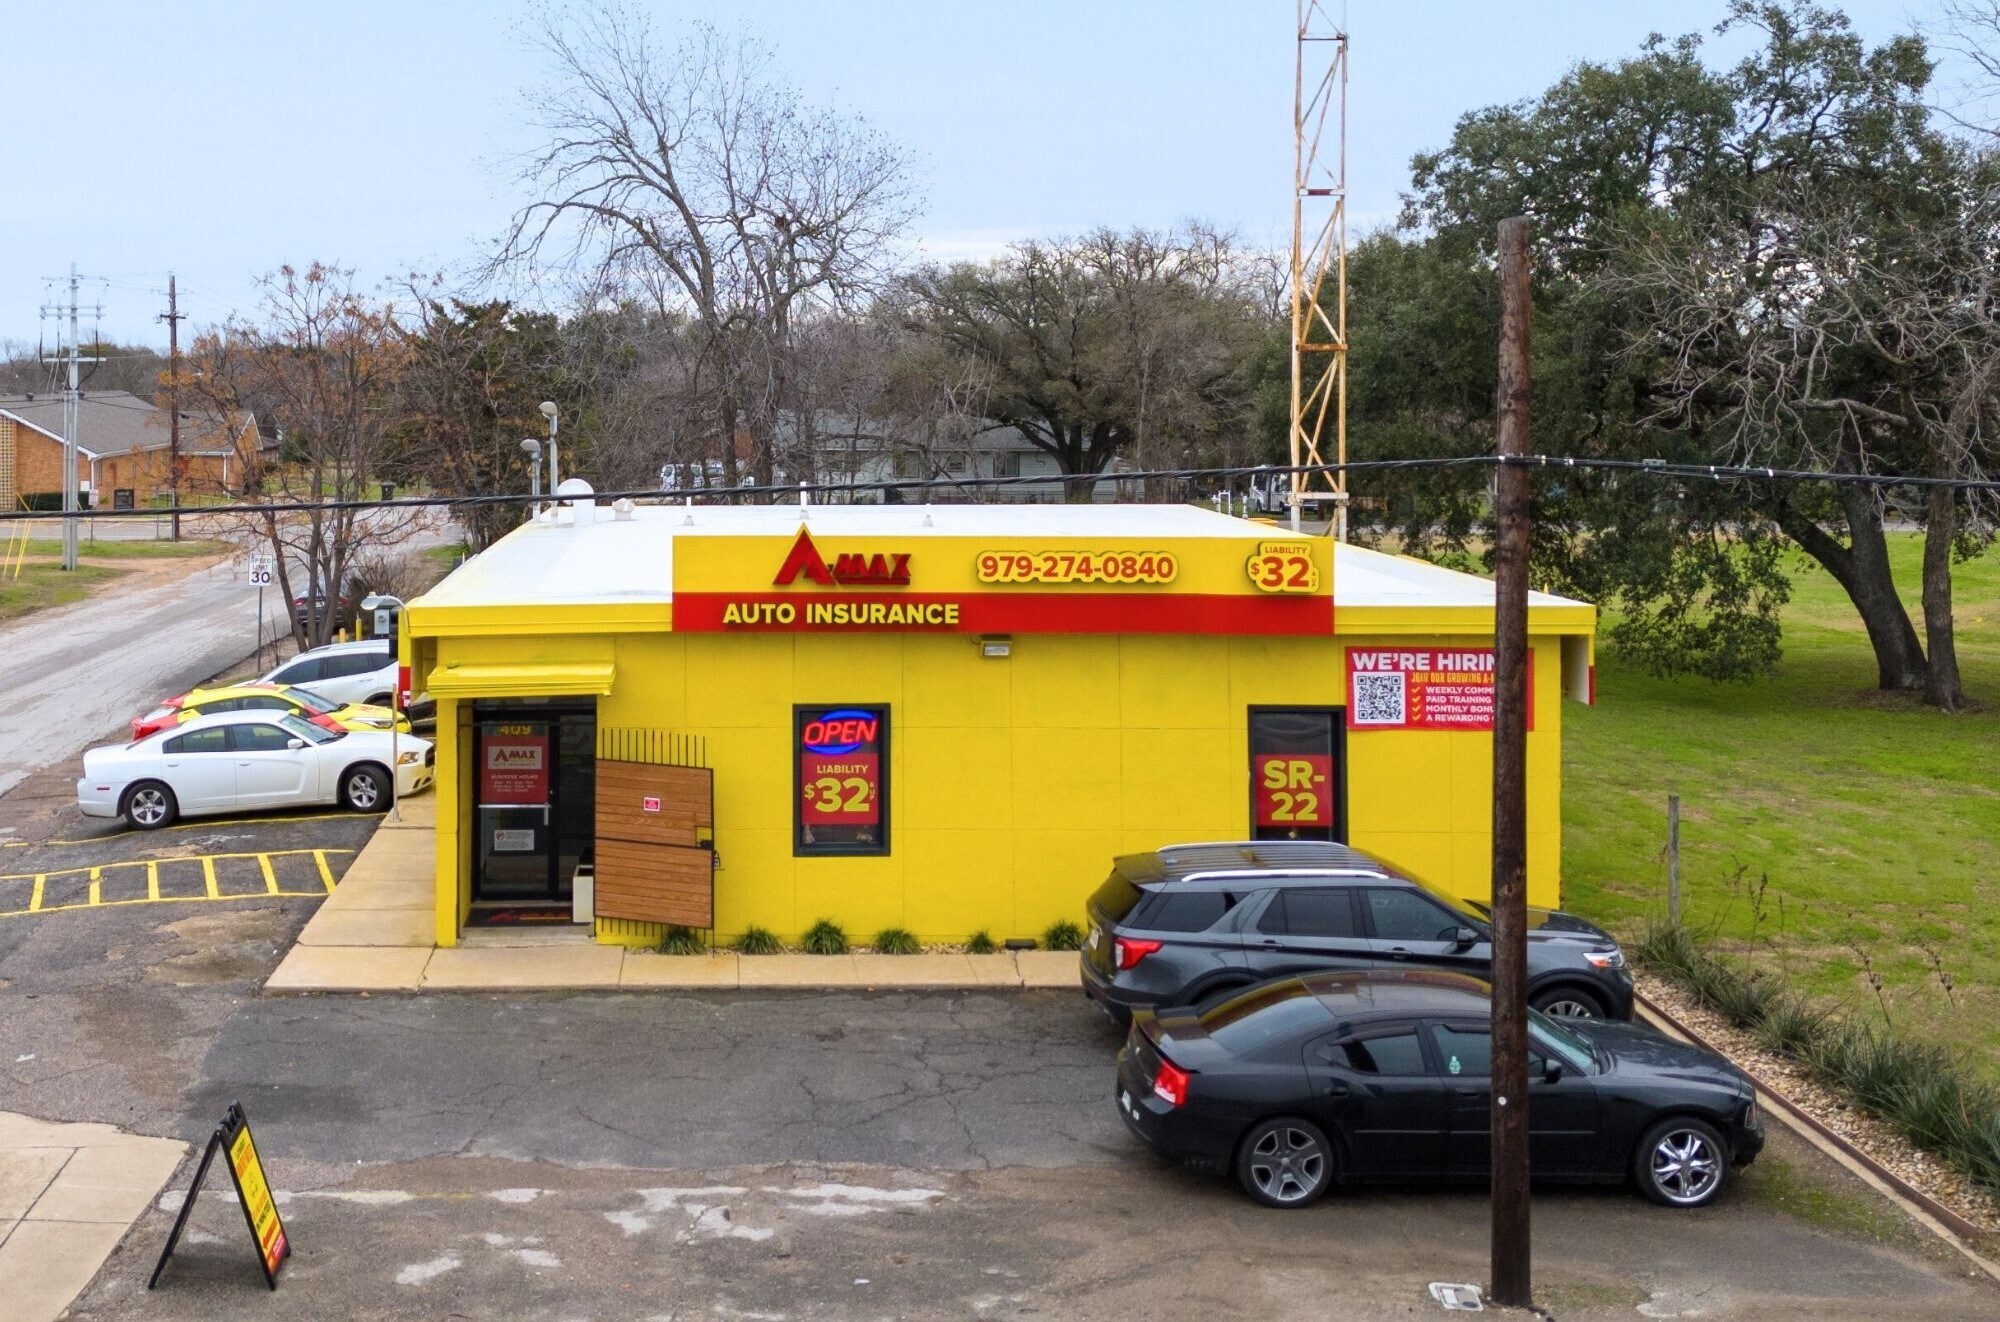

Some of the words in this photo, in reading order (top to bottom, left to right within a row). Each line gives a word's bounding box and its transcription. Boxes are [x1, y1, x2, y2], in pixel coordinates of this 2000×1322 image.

[1265, 546, 1307, 554] LIABILITY
[981, 555, 1174, 578] 979-274-0840
[251, 571, 270, 583] 30
[723, 603, 796, 624] AUTO
[807, 603, 959, 624] INSURANCE
[1352, 653, 1430, 670] WE'RE
[1437, 653, 1496, 671] HIRIN
[1411, 672, 1428, 683] JOIN
[1430, 672, 1445, 683] OUR
[1447, 672, 1481, 684] GROWING
[1425, 686, 1464, 694] WEEKLY
[1425, 695, 1447, 703] PAID
[1448, 695, 1492, 703] TRAINING
[1425, 705, 1468, 713] MONTHLY
[1435, 714, 1490, 722] REWARDING
[804, 720, 877, 744] OPEN
[816, 765, 868, 774] LIABILITY
[1263, 759, 1326, 789] SR-
[1270, 791, 1318, 821] 22
